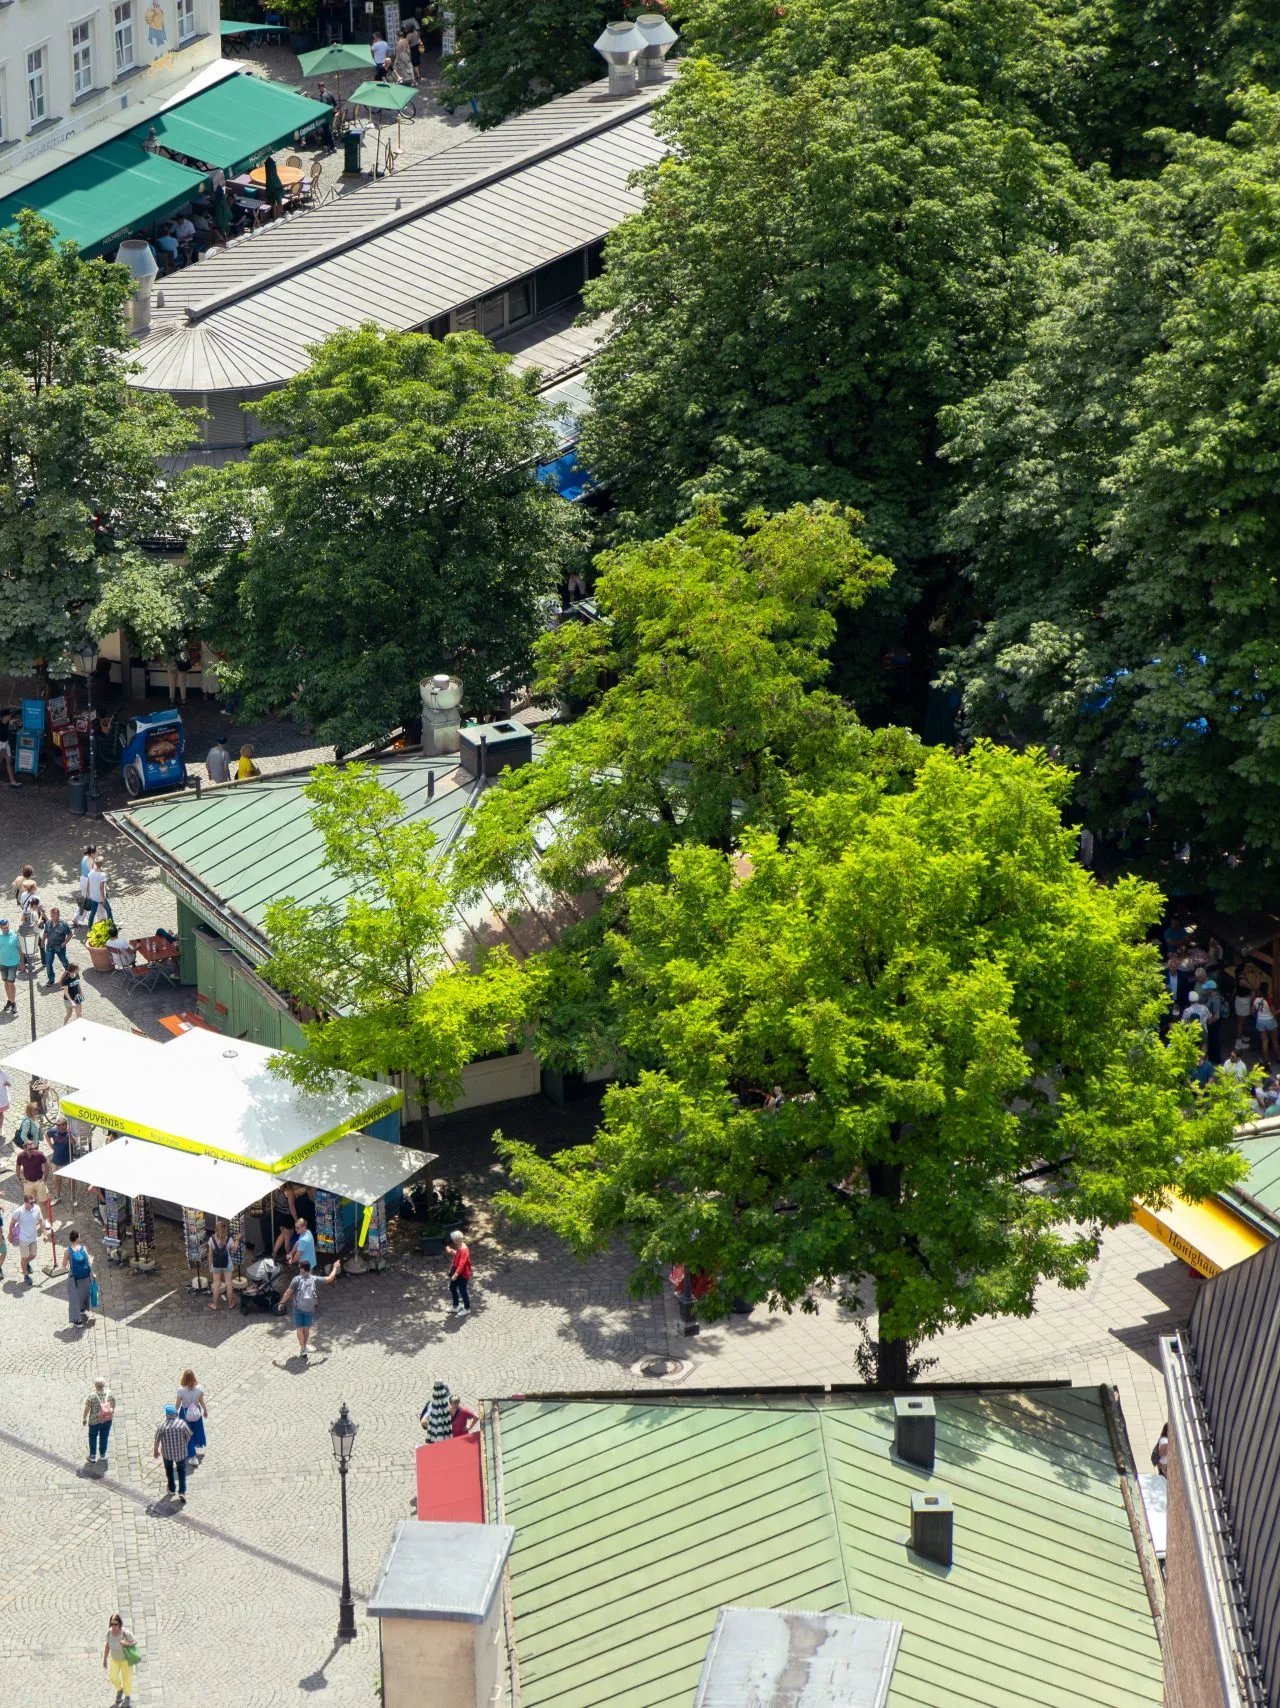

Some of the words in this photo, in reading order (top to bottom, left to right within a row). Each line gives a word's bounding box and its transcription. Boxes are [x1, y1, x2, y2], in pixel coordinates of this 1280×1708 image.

[78, 1109, 125, 1131] SOUVENIRS
[349, 1102, 393, 1131] HOLZWAREN
[286, 1141, 326, 1166] SOUVENIRS
